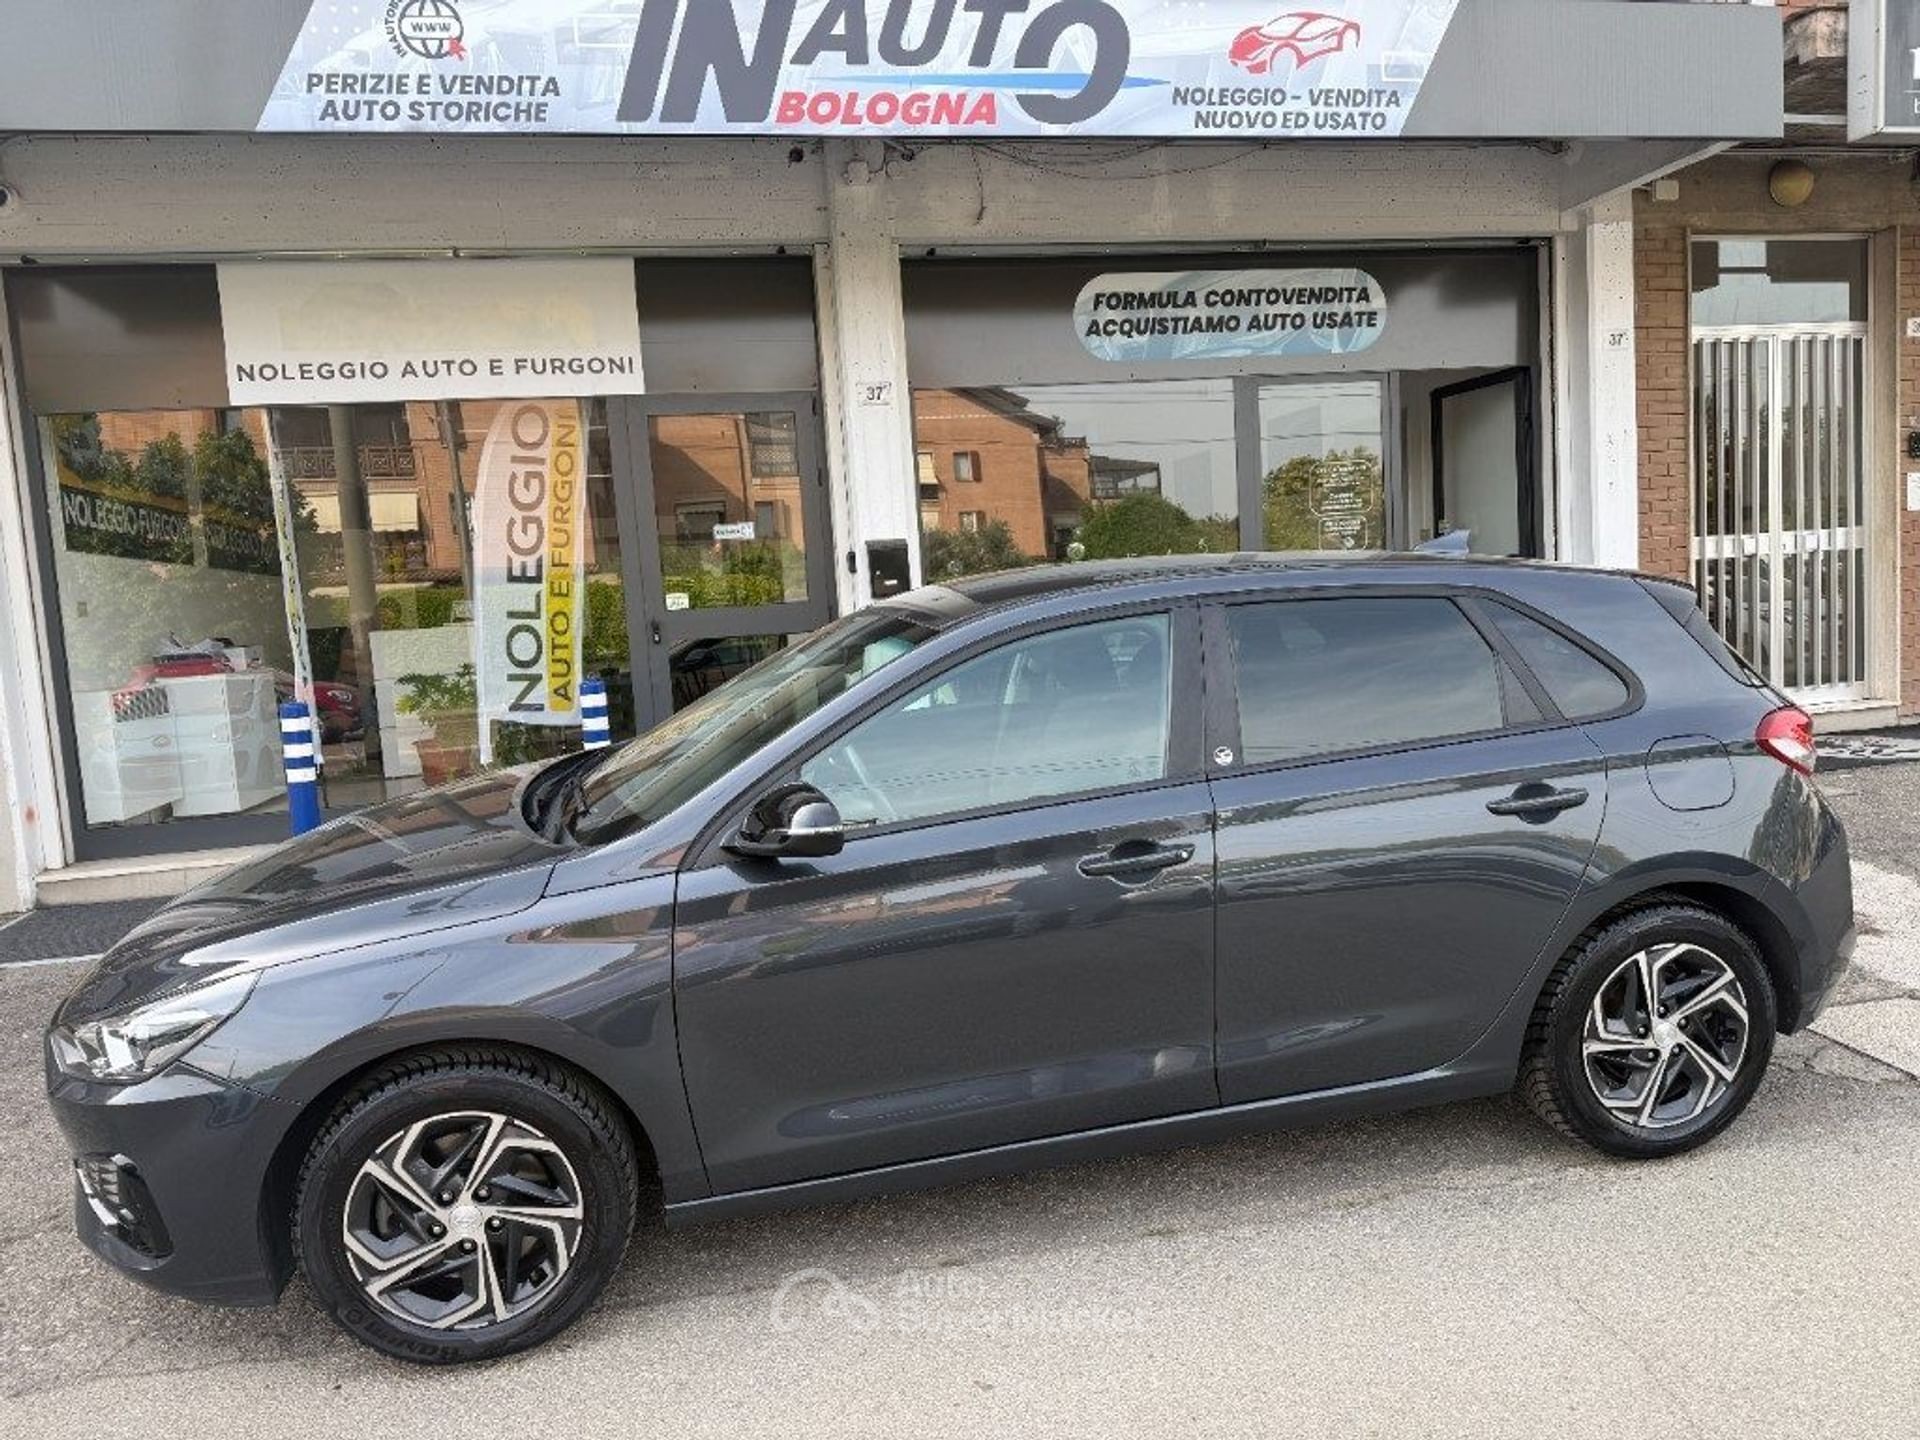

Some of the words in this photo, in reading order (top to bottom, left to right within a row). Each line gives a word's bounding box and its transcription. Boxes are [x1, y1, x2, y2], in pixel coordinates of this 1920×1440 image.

[305, 72, 409, 95] PERIZIE
[416, 74, 431, 95] E
[438, 74, 561, 97] VENDITA
[1171, 86, 1287, 107] NOLEGGIO
[1307, 88, 1401, 108] VENDITA
[318, 99, 402, 122] AUTO
[408, 99, 548, 123] STORICHE
[775, 91, 999, 126] BOLOGNA
[1194, 110, 1277, 129] NUOVO
[1281, 111, 1310, 129] ED
[1314, 111, 1387, 131] USATO
[1092, 289, 1198, 311] FORMULA
[1203, 286, 1371, 309] CONTOVENDITA
[1085, 315, 1241, 339] ACQUISTIAMO
[1247, 313, 1306, 333] AUTO
[1312, 311, 1378, 330] USATE
[236, 360, 389, 382] NOLEGGIO
[400, 358, 478, 379] AUTO
[489, 358, 504, 377] E
[514, 356, 635, 376] FURGONI
[551, 414, 578, 568] FURGONI
[63, 491, 137, 537] NOLEGGIO
[505, 402, 549, 713] NOLEGGIO
[551, 581, 571, 598] E
[551, 610, 573, 702] AUTO
